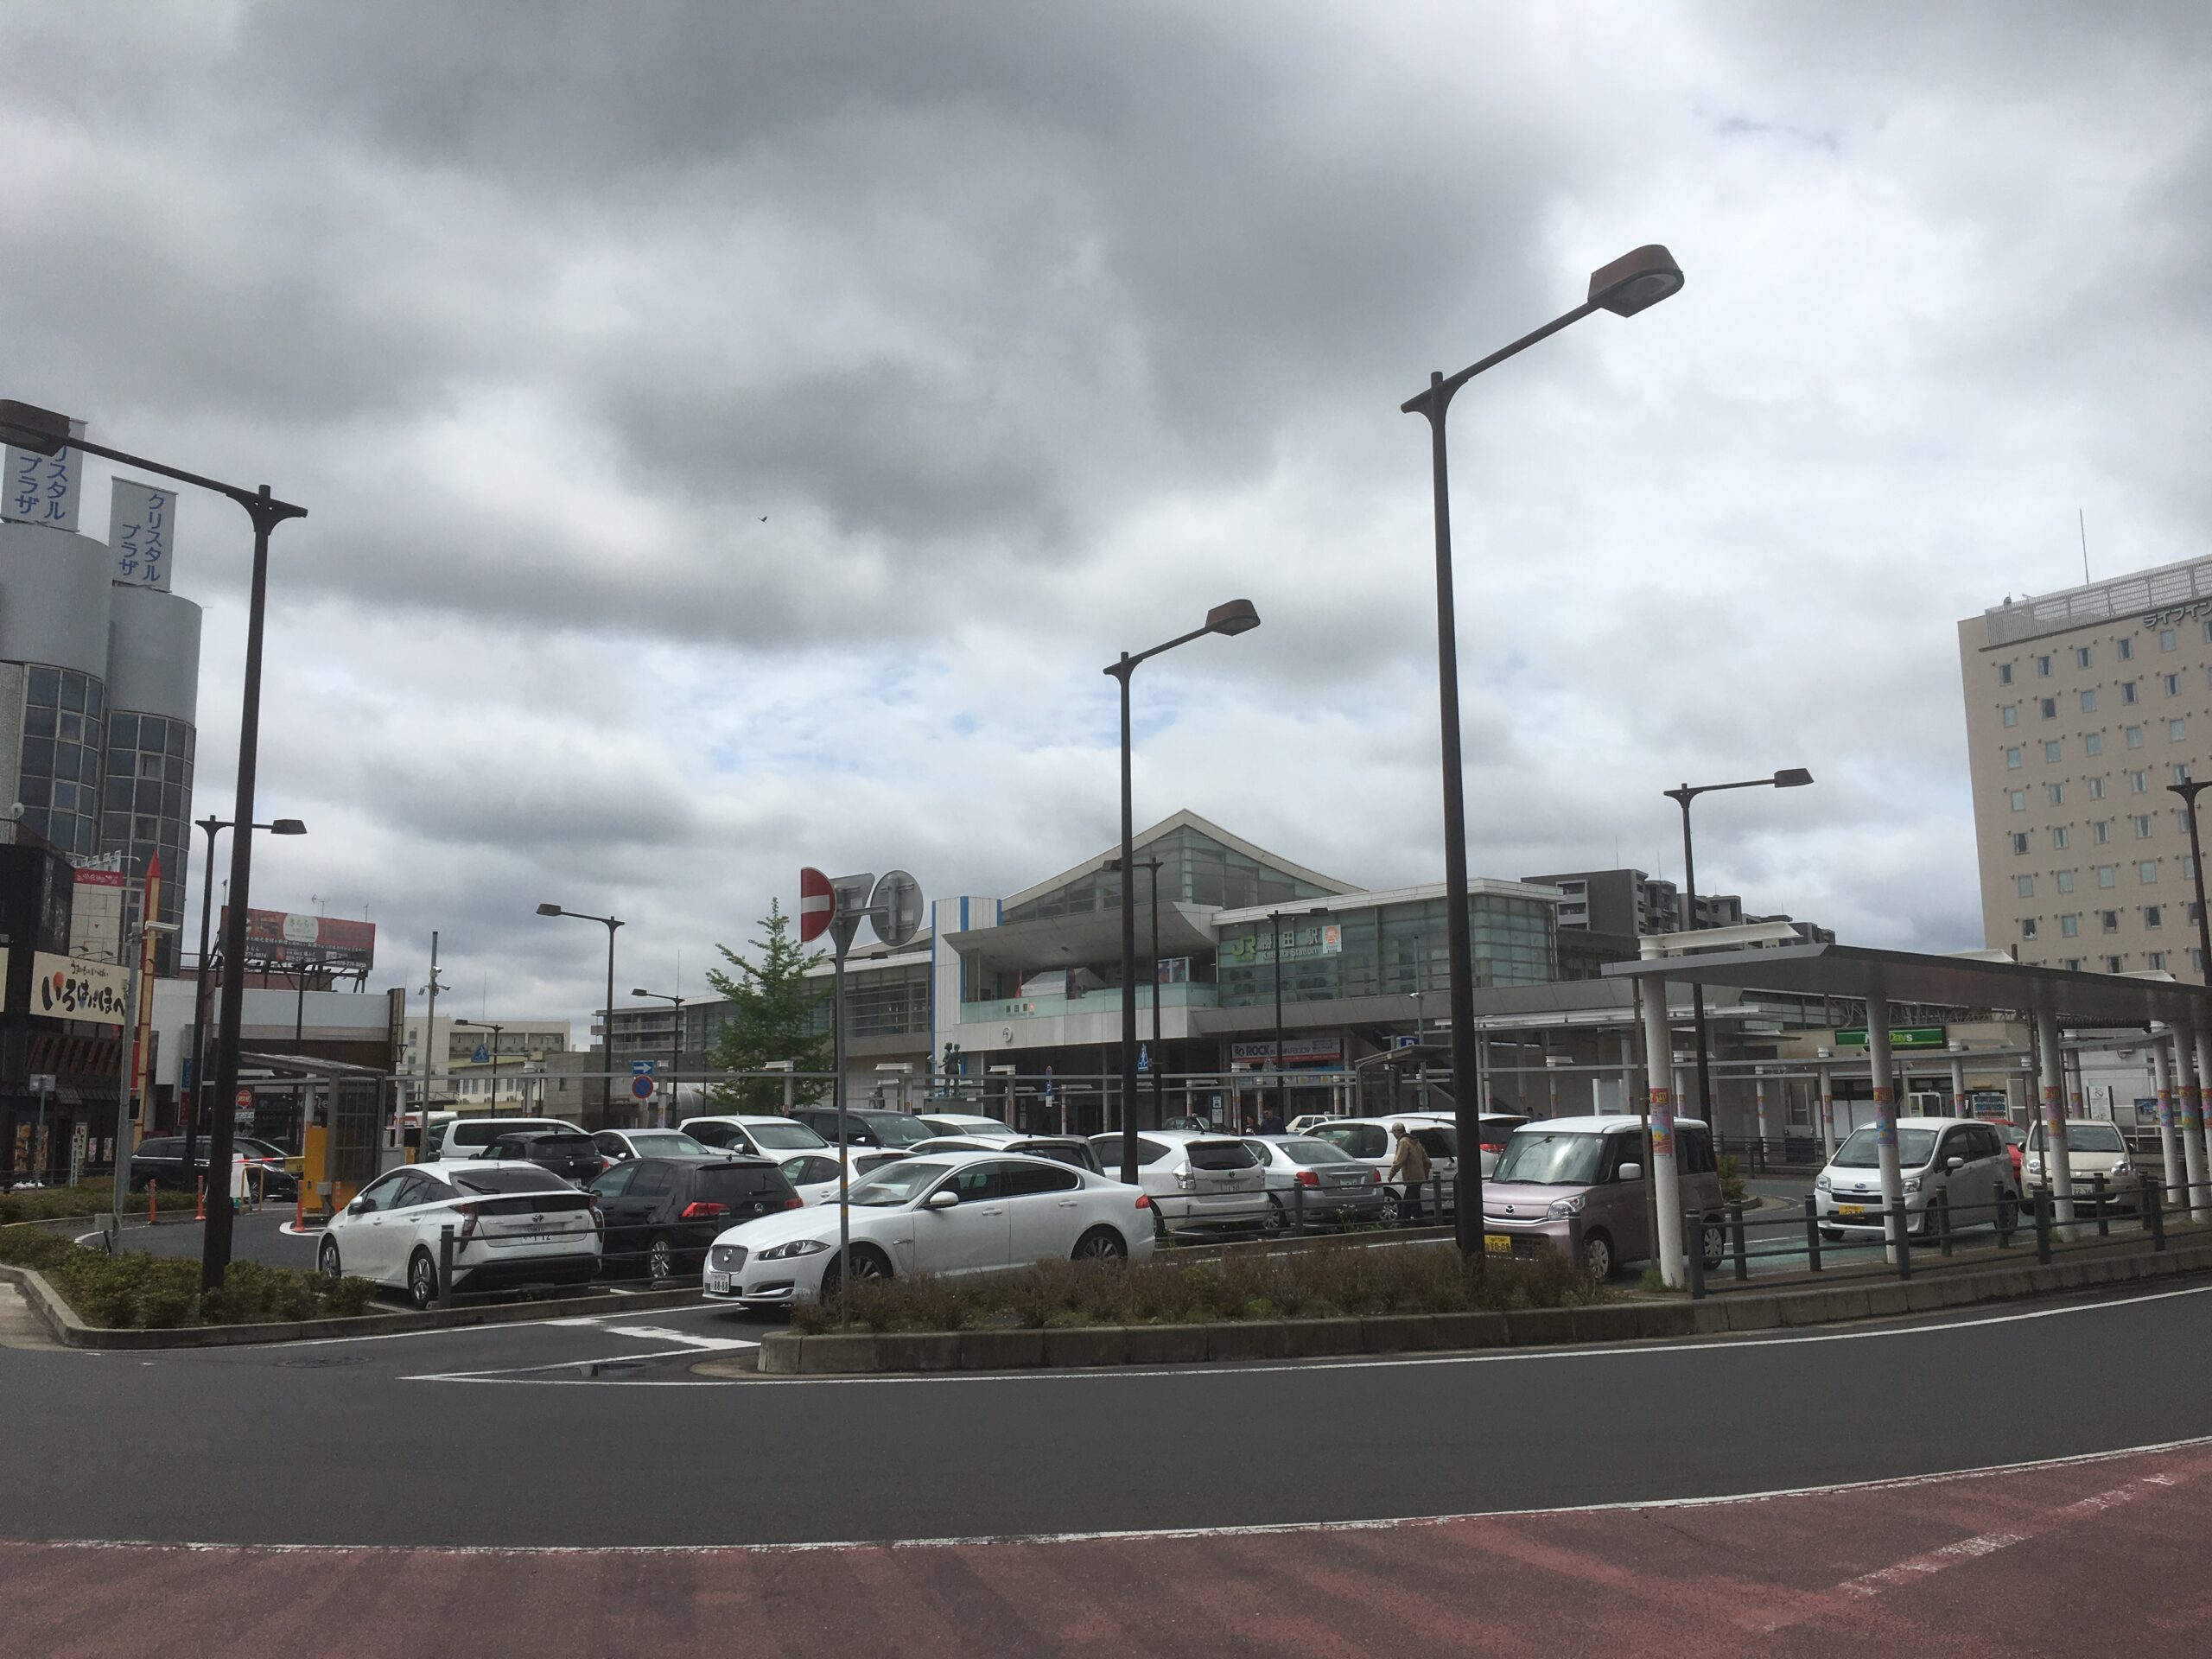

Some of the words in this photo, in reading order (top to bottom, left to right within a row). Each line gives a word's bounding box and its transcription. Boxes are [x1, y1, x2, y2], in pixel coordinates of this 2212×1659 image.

[15, 456, 42, 514] プラザ
[118, 524, 142, 575] プラザ
[143, 493, 165, 582] クリスタル
[1230, 935, 1256, 956] JR
[1246, 1046, 1270, 1055] ROCK
